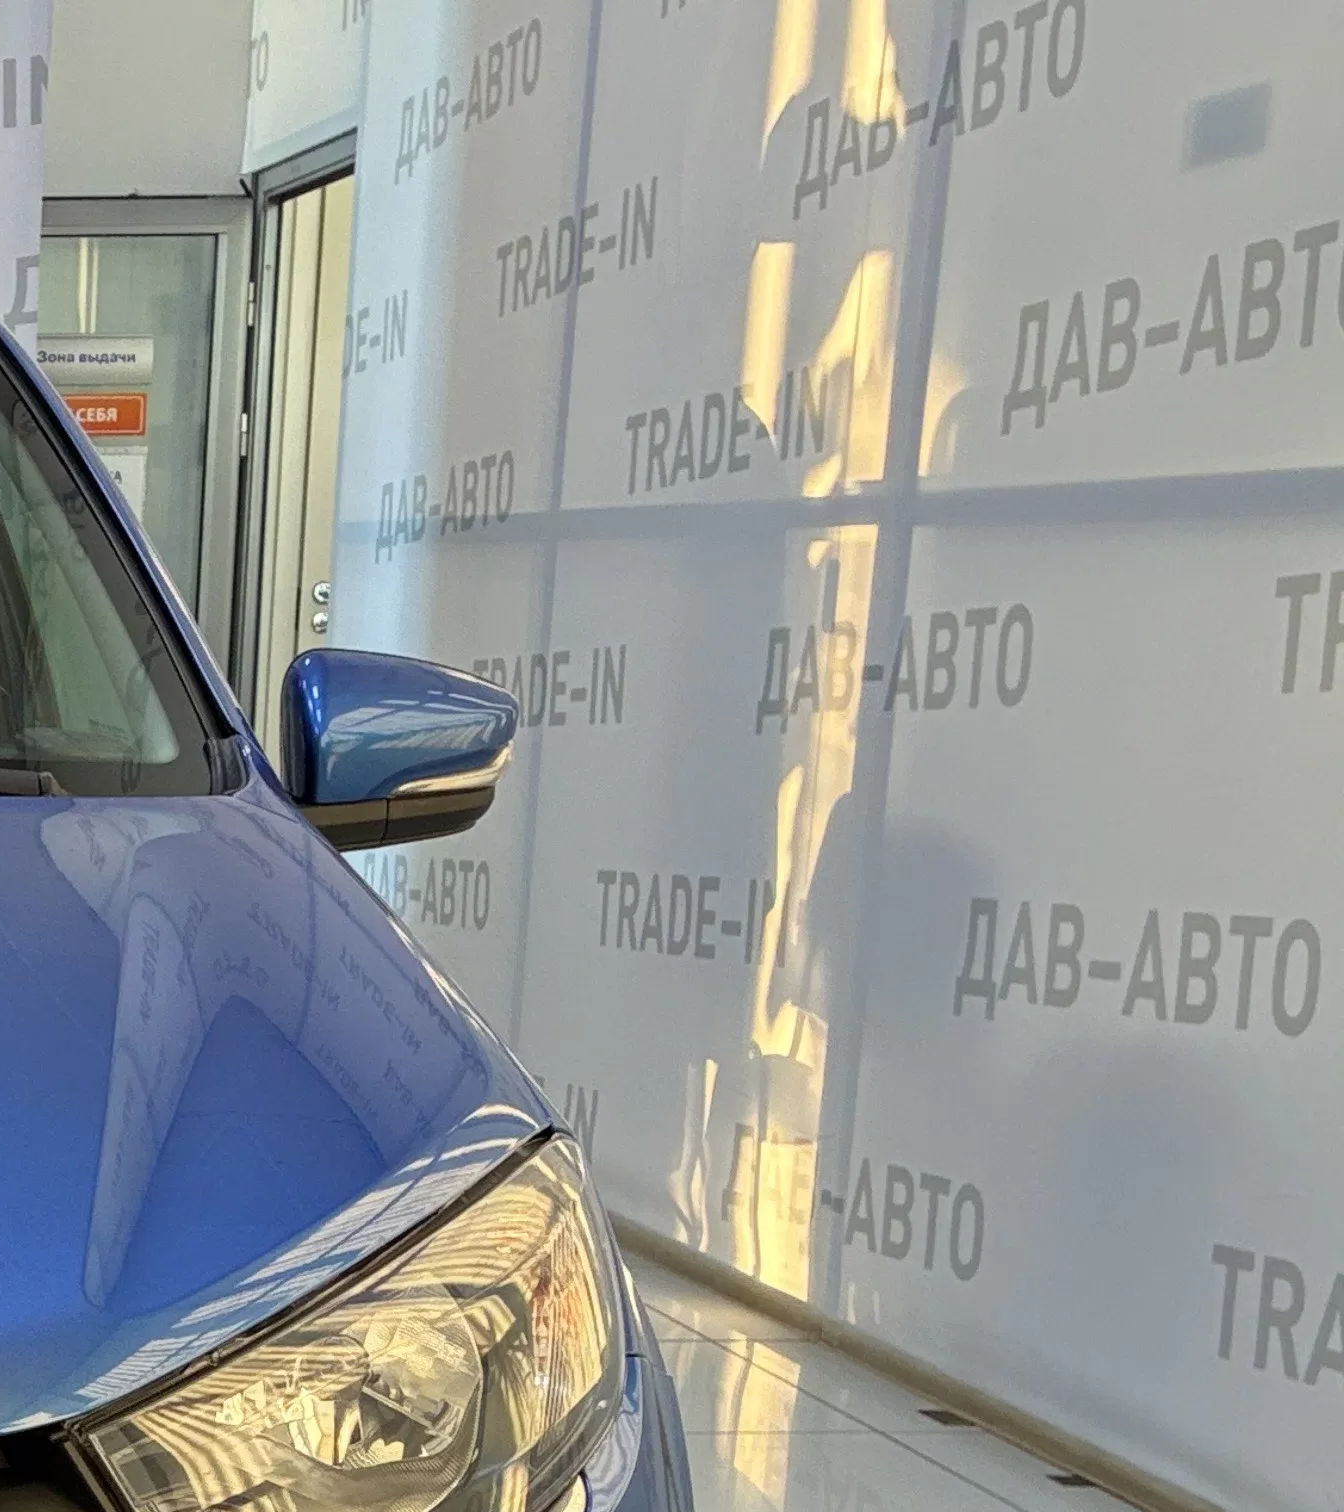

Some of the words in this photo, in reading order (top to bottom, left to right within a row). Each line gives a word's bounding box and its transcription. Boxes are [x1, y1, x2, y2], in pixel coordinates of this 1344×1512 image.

[395, 18, 542, 185] ДАВ-АВТО
[496, 176, 659, 318] TRADE-IN
[37, 350, 75, 364] Зона
[78, 352, 136, 364] выдачи
[1001, 220, 1344, 436] ДАВ-АВТ
[76, 407, 118, 423] СЕБЯ
[625, 365, 829, 496] TRADE-IN
[375, 451, 515, 563] ДАВ-АВТО
[755, 603, 1034, 735] ДАВ-АВТО
[952, 897, 1322, 1038] ДАВ-АВТО
